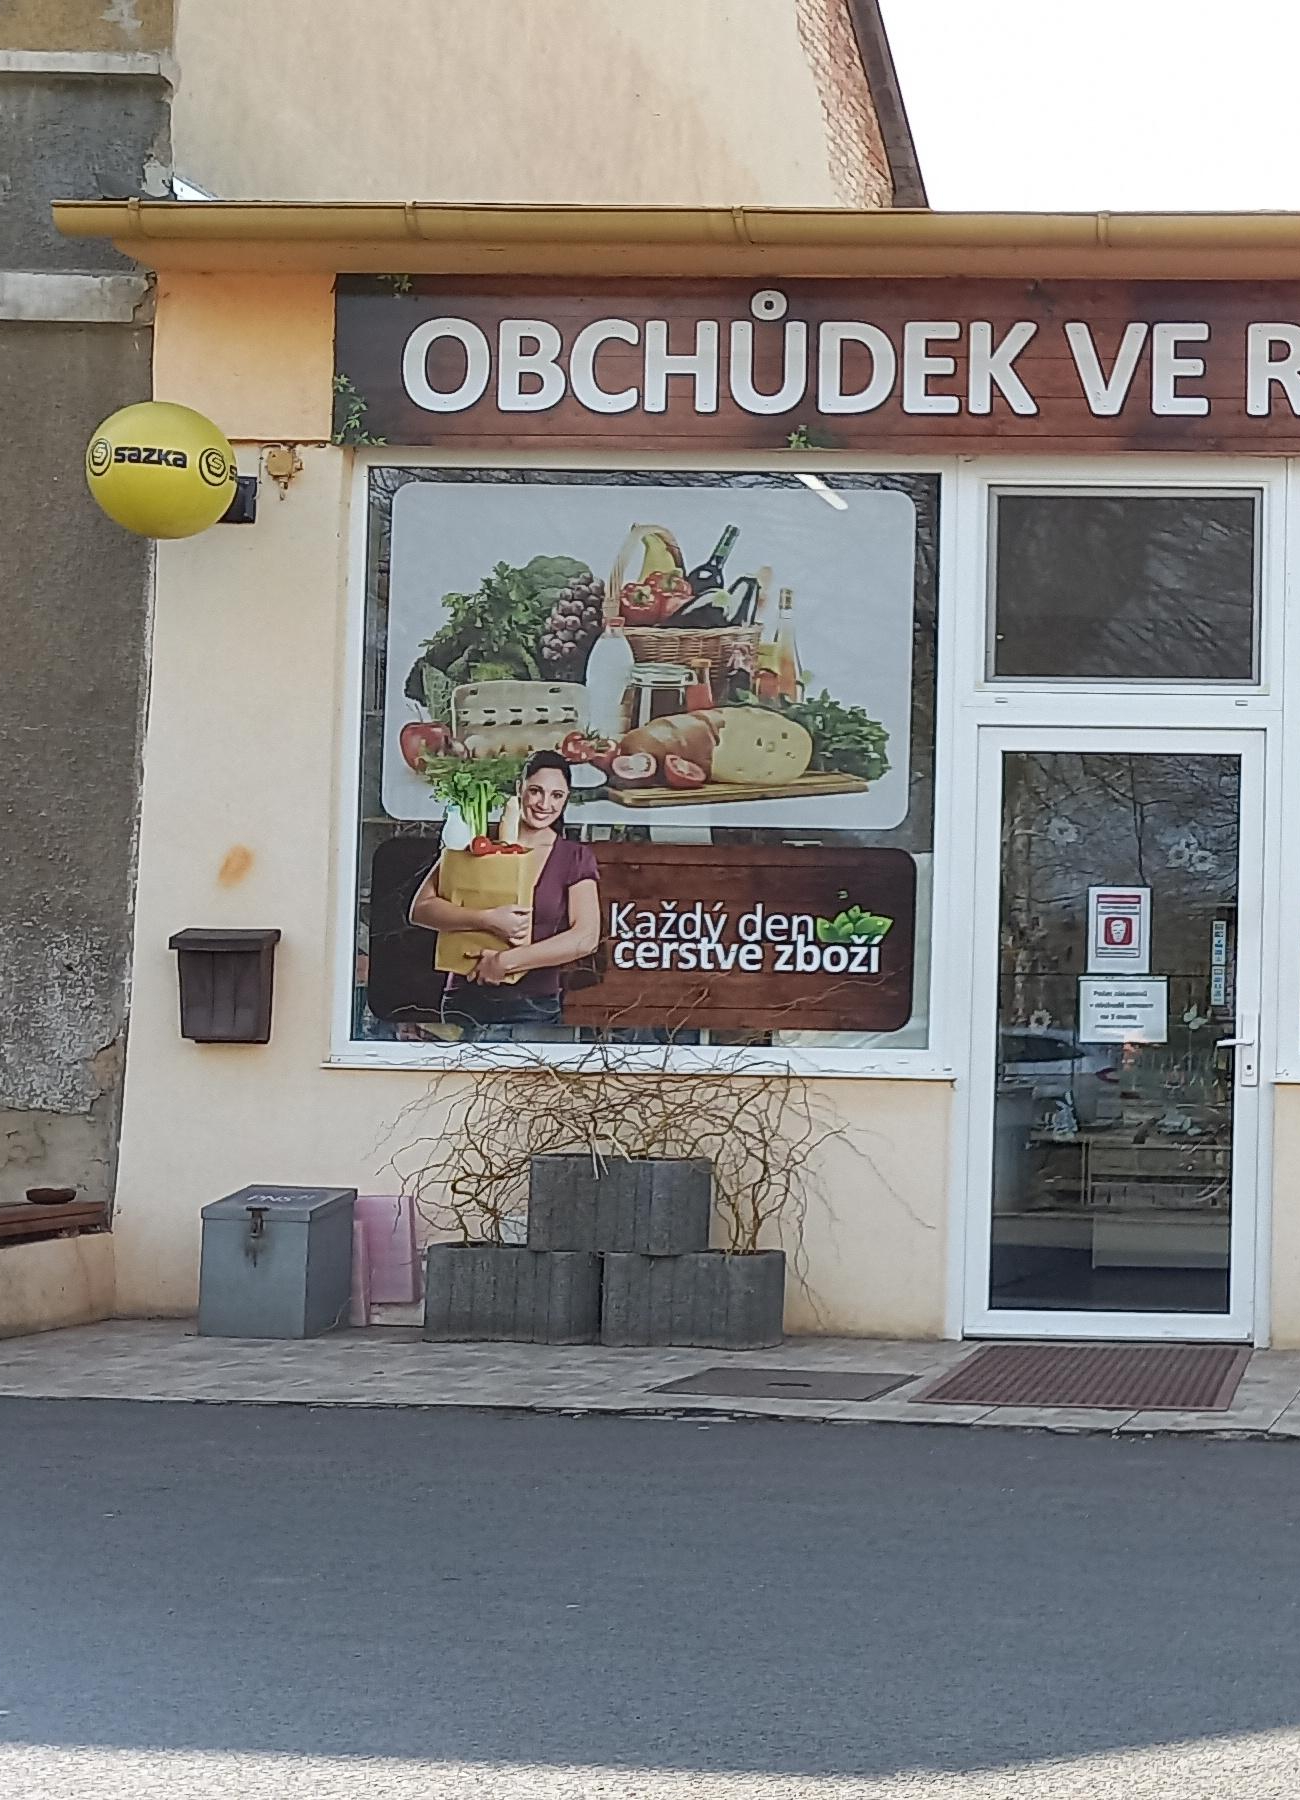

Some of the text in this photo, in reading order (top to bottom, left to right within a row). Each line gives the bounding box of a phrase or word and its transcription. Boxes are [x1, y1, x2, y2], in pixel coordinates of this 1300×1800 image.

[401, 289, 1038, 416] OBCHŮDEK
[1064, 321, 1210, 417] VE
[610, 900, 814, 946] Každý den
[773, 933, 884, 973] zboží
